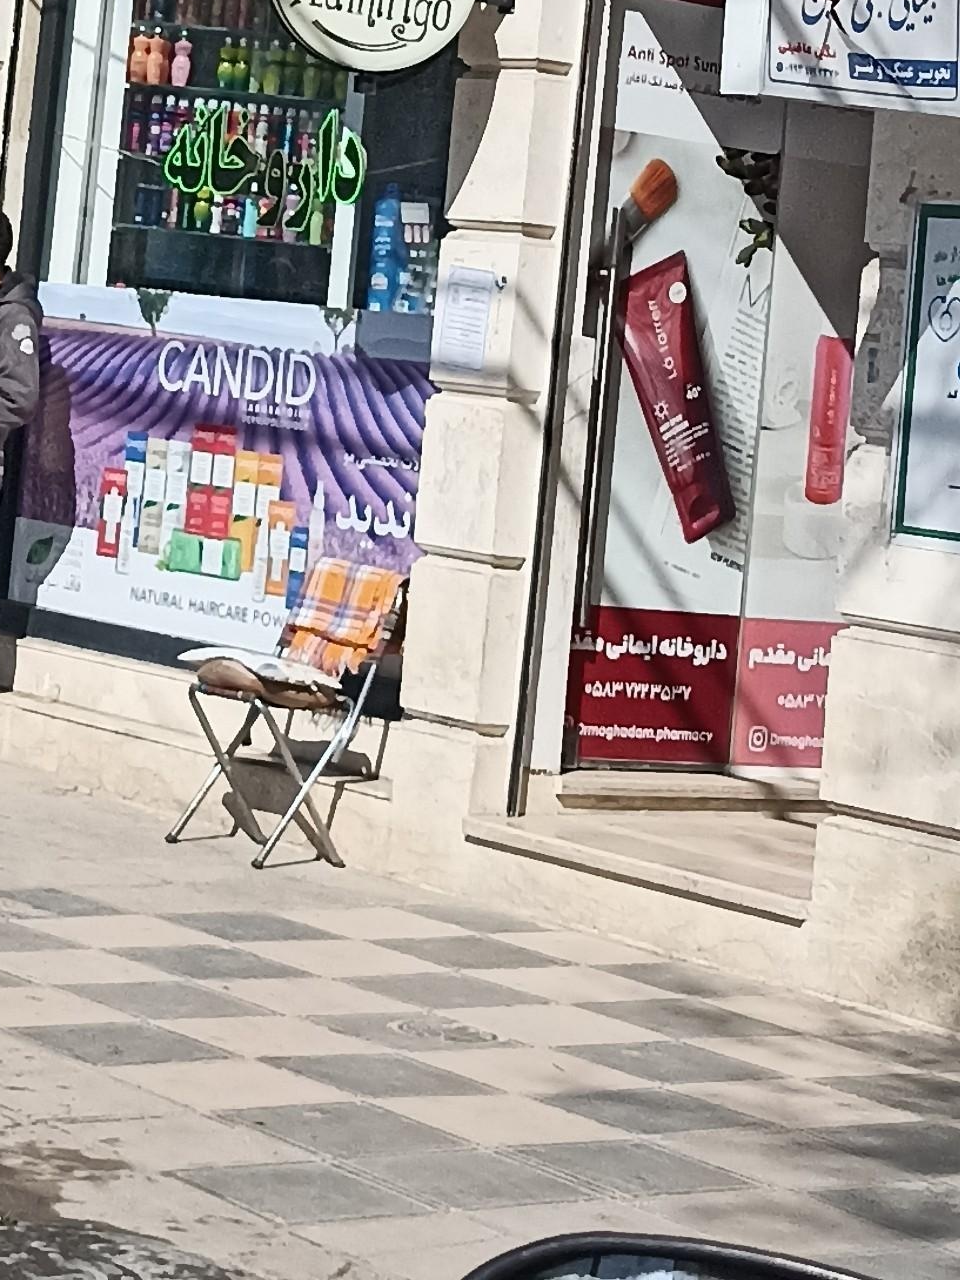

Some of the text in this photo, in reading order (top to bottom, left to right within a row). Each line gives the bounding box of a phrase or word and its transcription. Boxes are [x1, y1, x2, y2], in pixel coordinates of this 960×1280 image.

[627, 45, 655, 62] Anti
[658, 49, 690, 69] Spot
[164, 104, 368, 232] داروخانه
[158, 340, 316, 407] CANDID
[130, 586, 183, 610] NATURAL
[189, 598, 249, 622] HAIRCARE
[605, 633, 658, 661] ایمانی
[659, 636, 728, 667] داروخانه
[748, 643, 795, 669] مقدم
